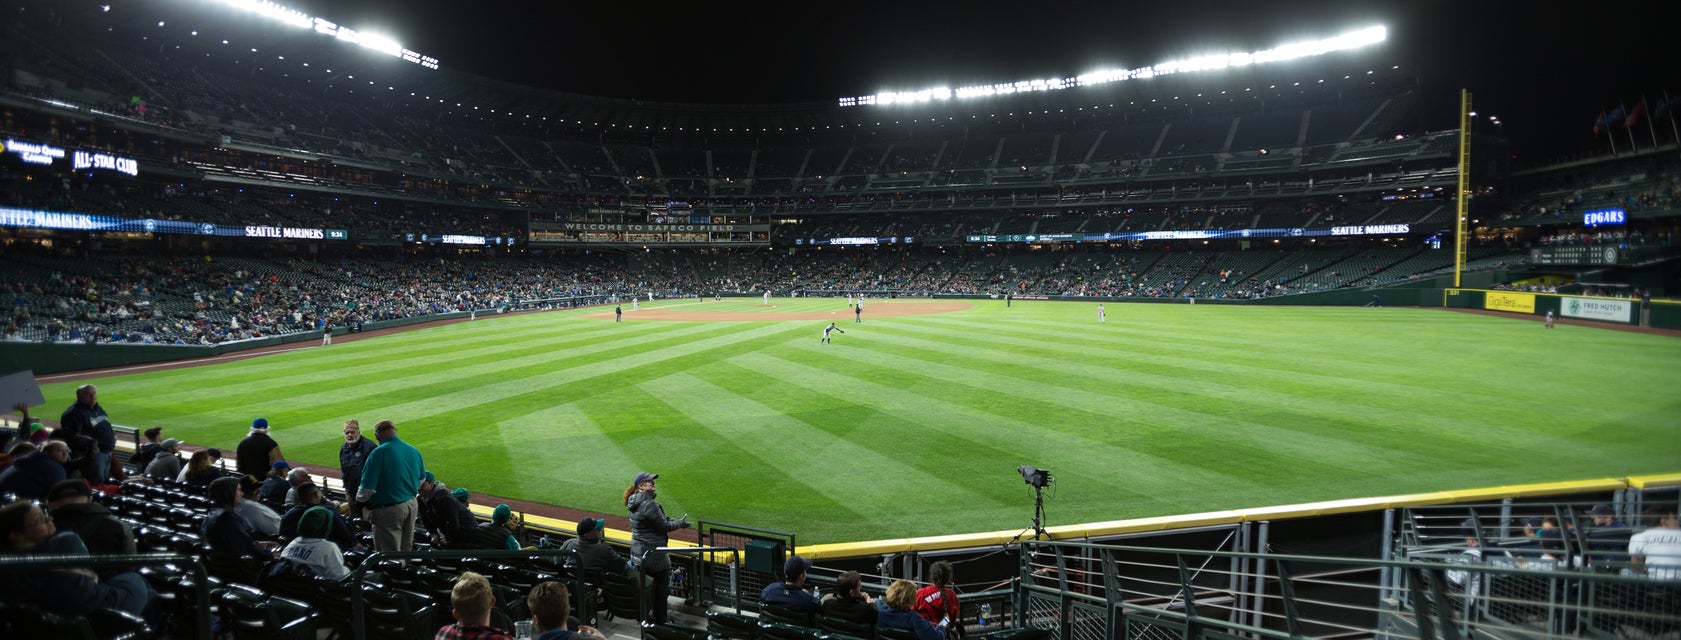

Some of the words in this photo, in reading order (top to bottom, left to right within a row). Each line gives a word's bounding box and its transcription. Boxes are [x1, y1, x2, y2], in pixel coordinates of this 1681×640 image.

[117, 158, 138, 176] CLUB
[35, 211, 92, 229] MARINERS
[1584, 210, 1624, 224] EDGARS
[245, 225, 281, 237] SEATTLE
[283, 227, 324, 239] MARINERS
[565, 223, 622, 231] WELCOME
[1331, 225, 1363, 235] SEATTLE
[1365, 223, 1409, 234] MARINERS
[1488, 295, 1516, 309] GigaTera
[1583, 302, 1599, 310] FRED
[1600, 303, 1622, 312] HUTCH
